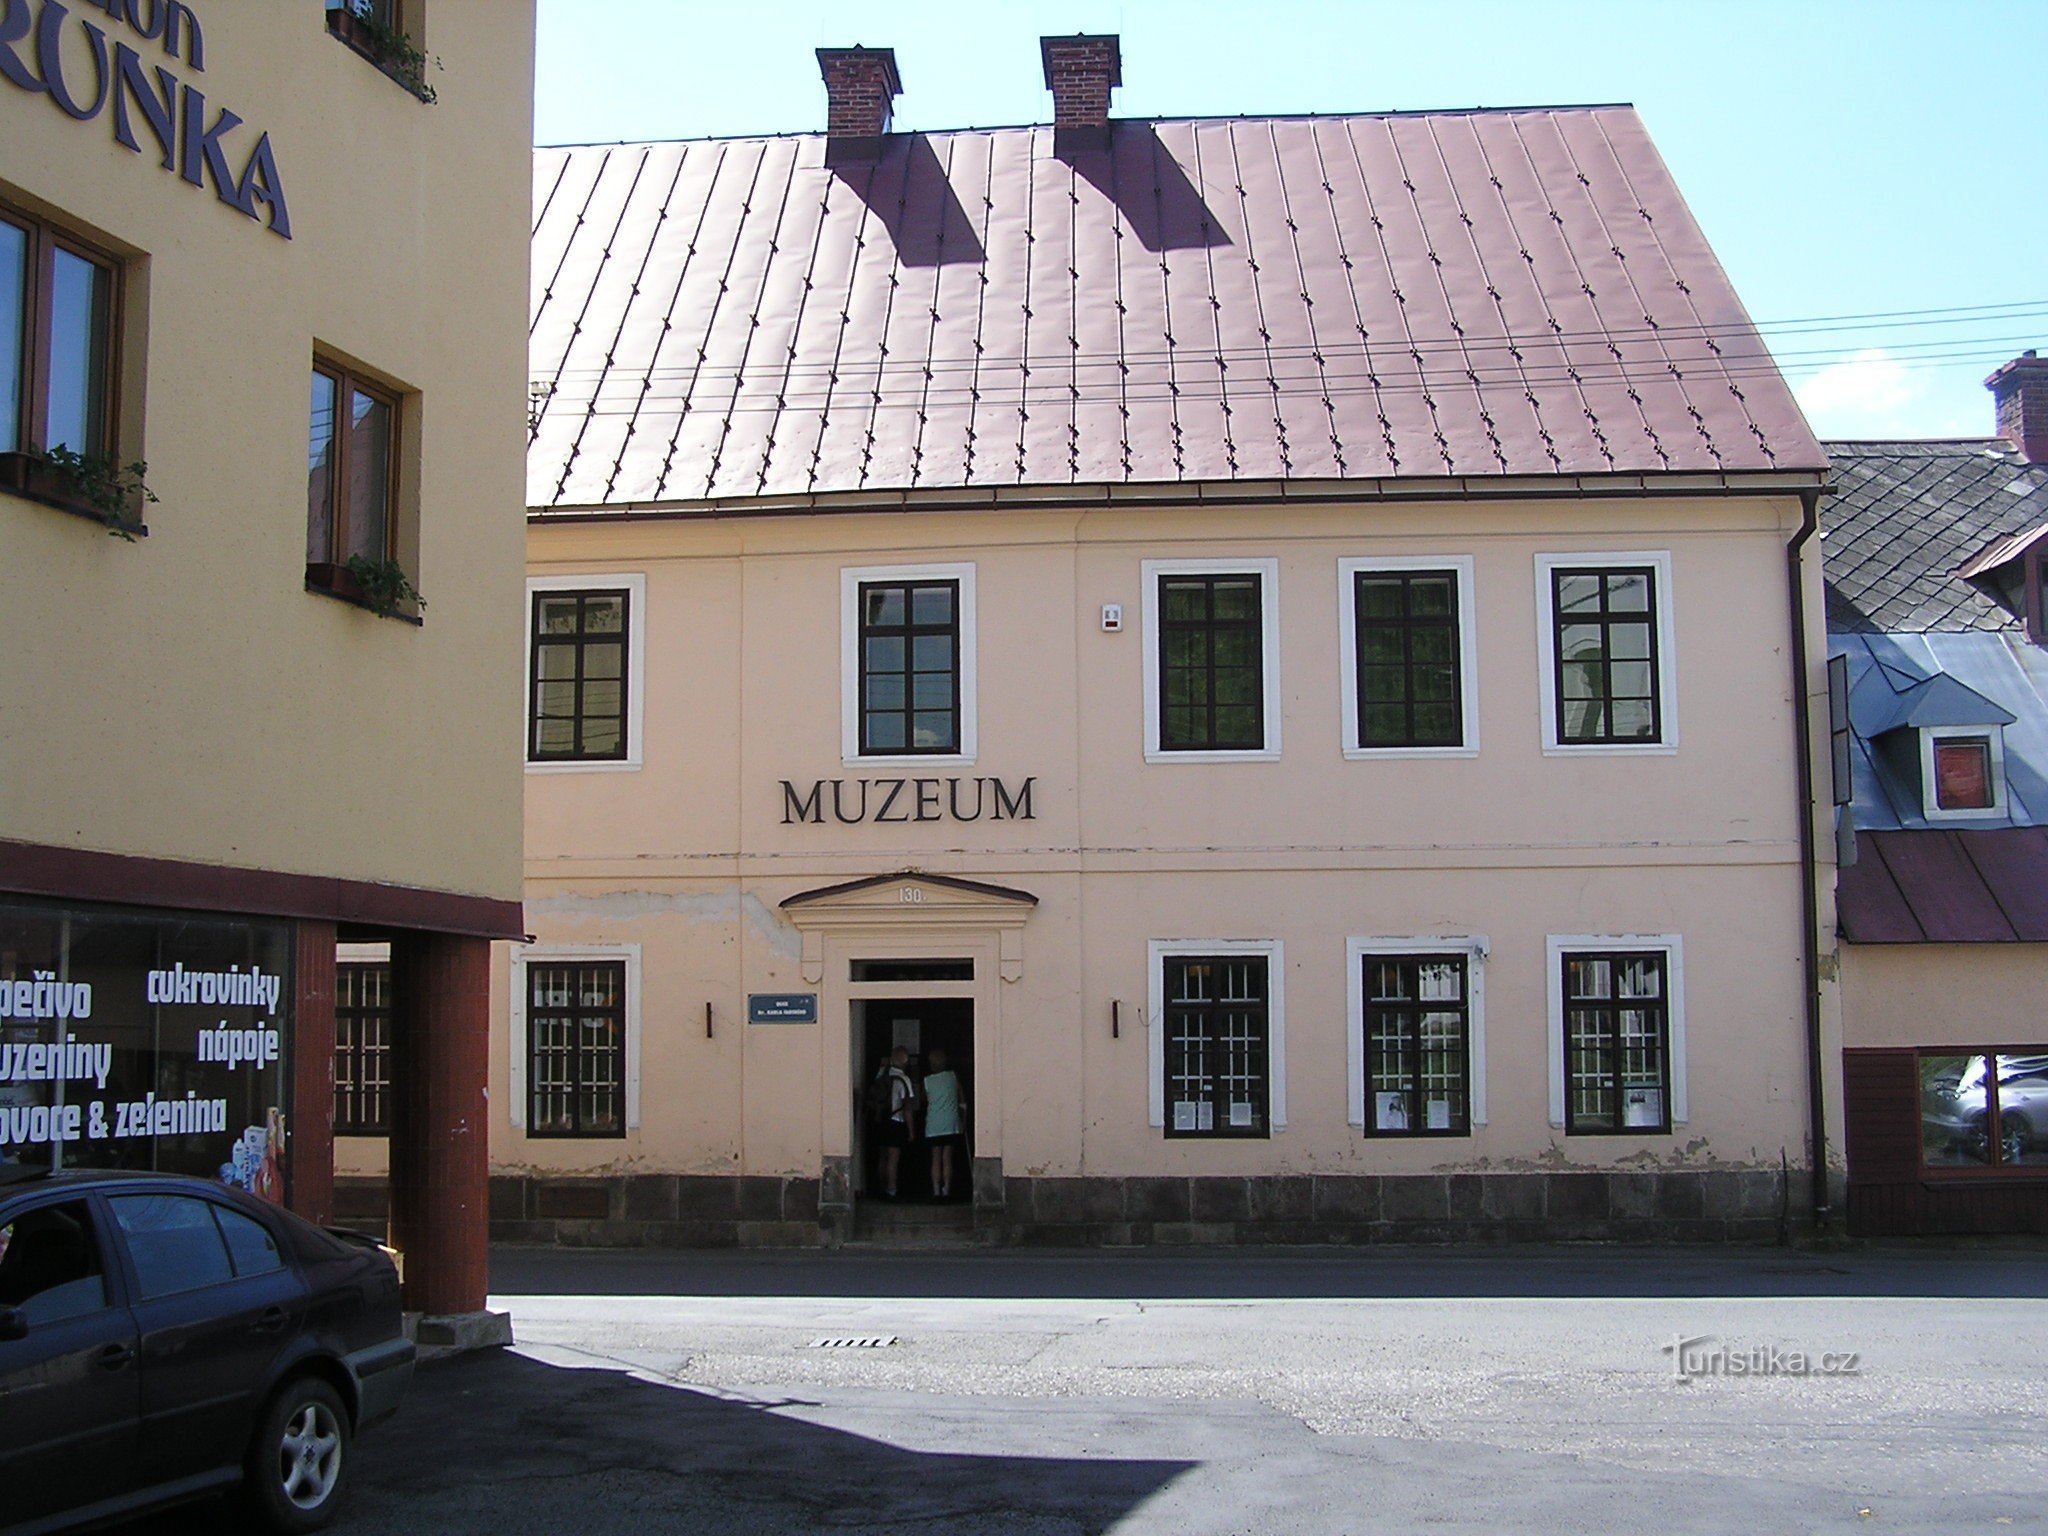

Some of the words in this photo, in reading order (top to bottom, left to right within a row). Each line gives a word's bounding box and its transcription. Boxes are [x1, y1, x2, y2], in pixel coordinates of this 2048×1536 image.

[778, 777, 1038, 825] MUZEUM
[148, 962, 280, 1015] cukrovinky
[198, 1020, 279, 1070] nápoje
[88, 1100, 109, 1139] &
[115, 1091, 227, 1138] zelenina
